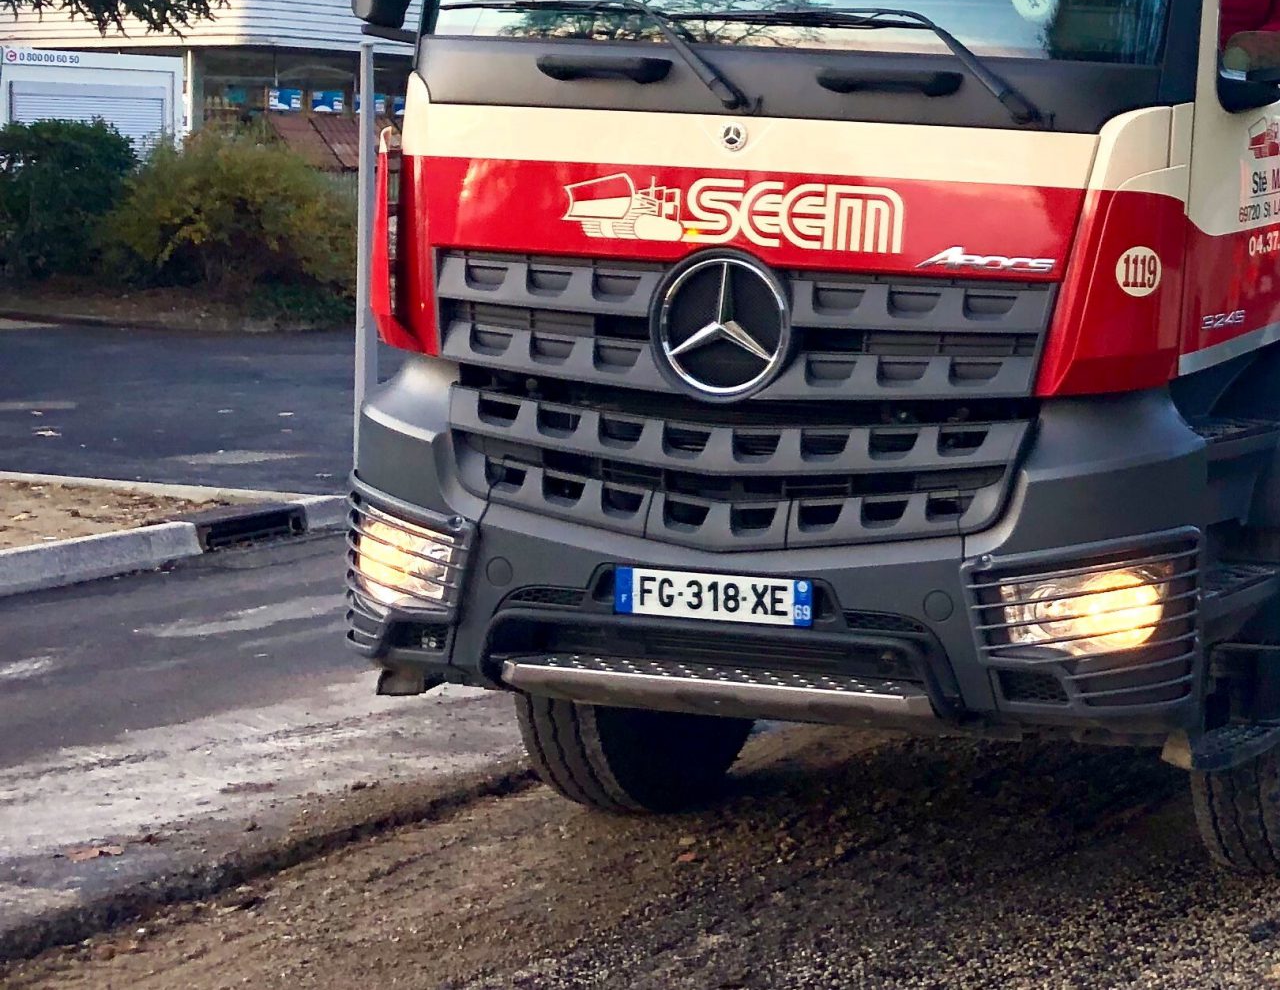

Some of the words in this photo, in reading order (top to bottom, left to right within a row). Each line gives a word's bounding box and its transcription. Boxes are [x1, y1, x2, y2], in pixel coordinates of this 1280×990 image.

[19, 52, 25, 61] 0
[26, 52, 43, 62] 800
[681, 178, 904, 254] SEEM
[1263, 201, 1271, 218] St
[1122, 254, 1156, 289] 1119
[621, 593, 627, 603] F
[639, 575, 788, 617] FG-318-XE
[794, 604, 811, 621] 69
